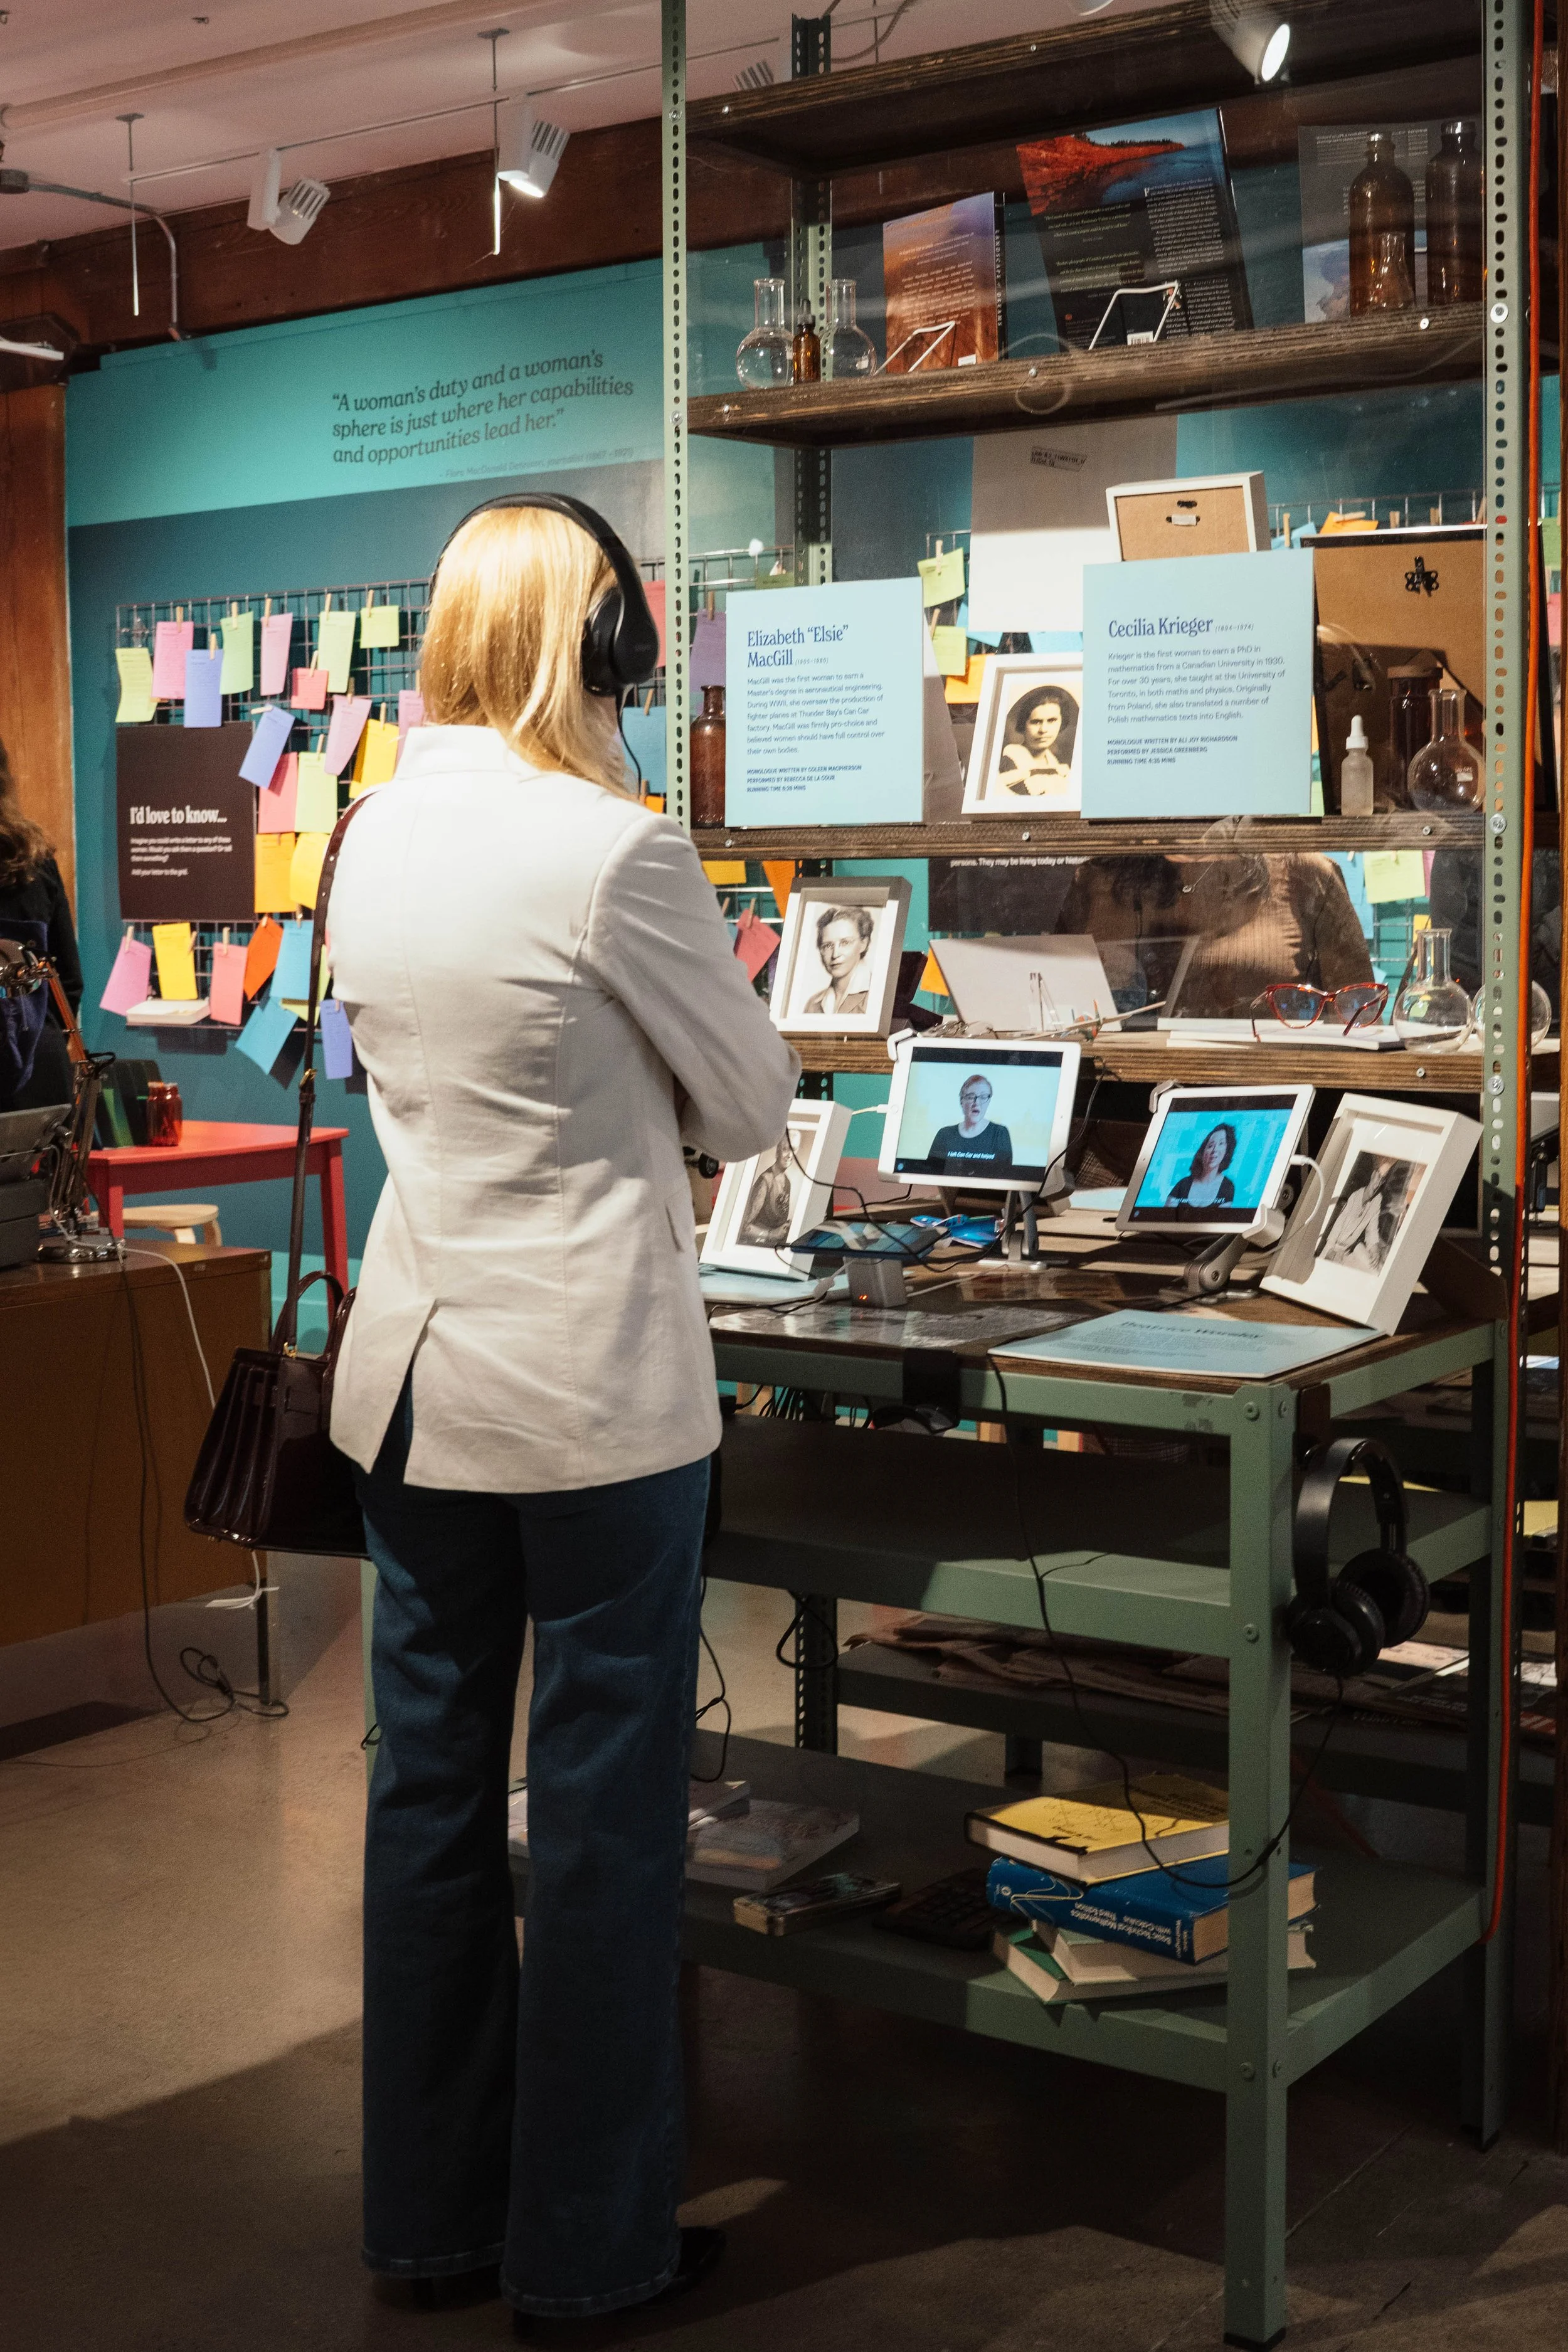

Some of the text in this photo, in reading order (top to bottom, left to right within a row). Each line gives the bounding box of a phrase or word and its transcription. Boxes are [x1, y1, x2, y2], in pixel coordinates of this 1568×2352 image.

[332, 349, 603, 411] “A woman’s duty and a woman’s
[333, 376, 634, 440] sphere is just where her capabilities
[333, 445, 364, 464] and
[368, 429, 480, 465] opportunities
[484, 415, 521, 440] lead
[525, 408, 564, 432] her.”
[1109, 618, 1154, 638] Cecilia
[1159, 616, 1213, 637] Krieger
[748, 624, 848, 647] Elizabeth “Elsie”
[1237, 645, 1253, 653] PhD
[748, 649, 793, 667] MacGill
[1156, 662, 1174, 670] from
[1182, 661, 1216, 669] Canadian
[1217, 659, 1255, 667] University
[747, 677, 770, 685] MacGill
[1189, 674, 1213, 682] taught
[1238, 671, 1276, 679] University
[1277, 669, 1287, 678] of
[805, 685, 844, 693] aeronautical
[844, 684, 882, 692] engineering.
[1147, 688, 1163, 696] both
[1205, 686, 1234, 695] physics.
[1236, 684, 1272, 694] Originally
[841, 696, 876, 704] production
[1108, 702, 1125, 711] from
[1185, 699, 1223, 707] translated
[1231, 697, 1259, 706] number
[1261, 696, 1270, 704] of
[747, 712, 768, 721] fighter
[825, 709, 842, 717] Bay's
[1215, 711, 1243, 720] English.
[811, 721, 829, 729] firmly
[835, 731, 845, 739] full
[130, 806, 145, 824] I’d
[146, 805, 171, 824] love
[171, 807, 184, 824] to
